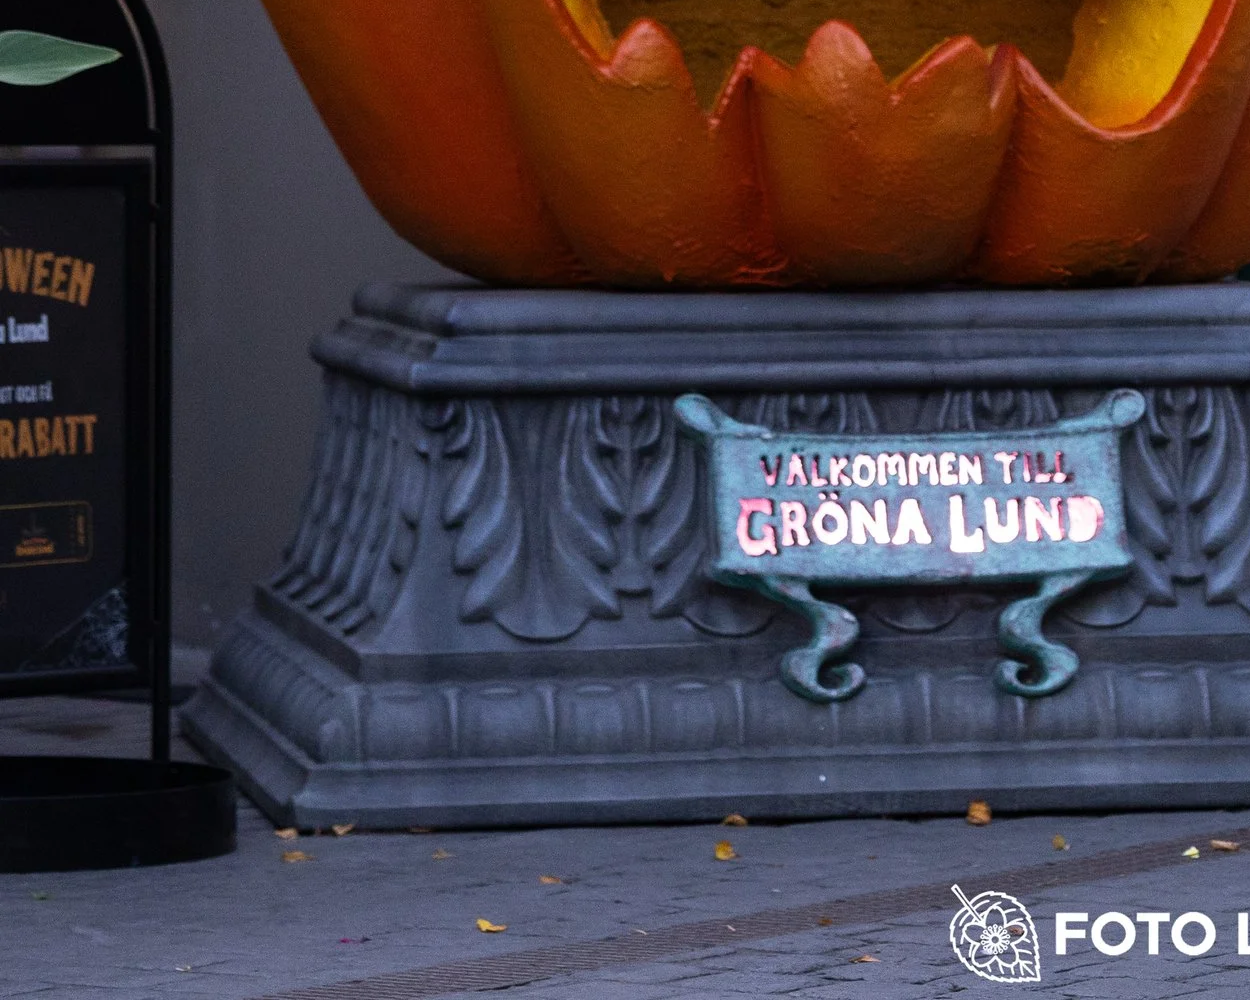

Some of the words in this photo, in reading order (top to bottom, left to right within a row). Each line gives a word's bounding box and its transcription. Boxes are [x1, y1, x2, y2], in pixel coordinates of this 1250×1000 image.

[0, 246, 96, 307] WEEN
[0, 414, 98, 461] RABATT
[758, 446, 984, 487] VÄLKOMMEN
[993, 450, 1075, 485] TILL
[736, 491, 932, 557] GRÖNA
[949, 494, 1105, 554] LUND
